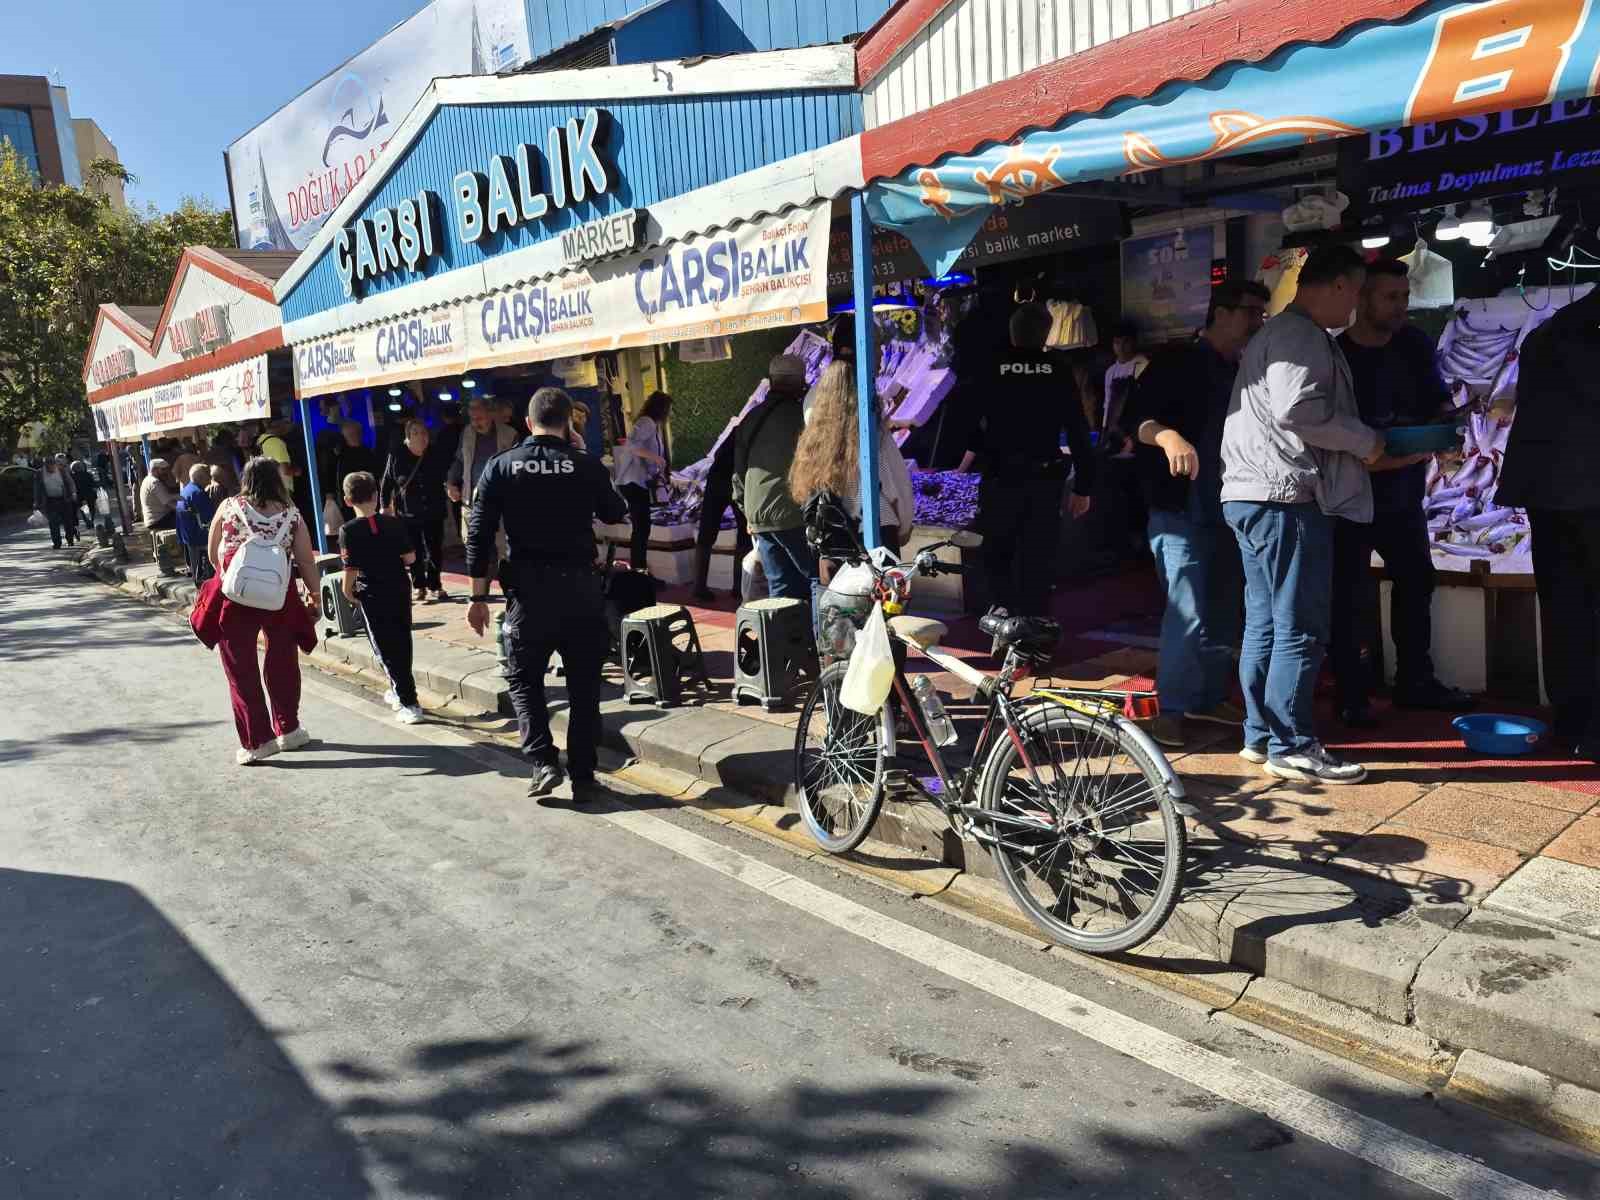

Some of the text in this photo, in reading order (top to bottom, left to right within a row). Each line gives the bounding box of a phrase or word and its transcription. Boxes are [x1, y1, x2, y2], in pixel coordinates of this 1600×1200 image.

[1403, 0, 1600, 128] B
[1367, 97, 1600, 160] BESLE
[334, 108, 608, 297] ÇARŞI BALIK
[1368, 181, 1432, 204] Tadına
[1436, 159, 1545, 192] Doyulmaz
[562, 209, 636, 262] MARKET
[1027, 223, 1081, 246] market
[740, 236, 810, 283] BALIK
[549, 288, 593, 321] BALIK
[335, 346, 356, 366] BALIK
[422, 323, 453, 347] BALIK
